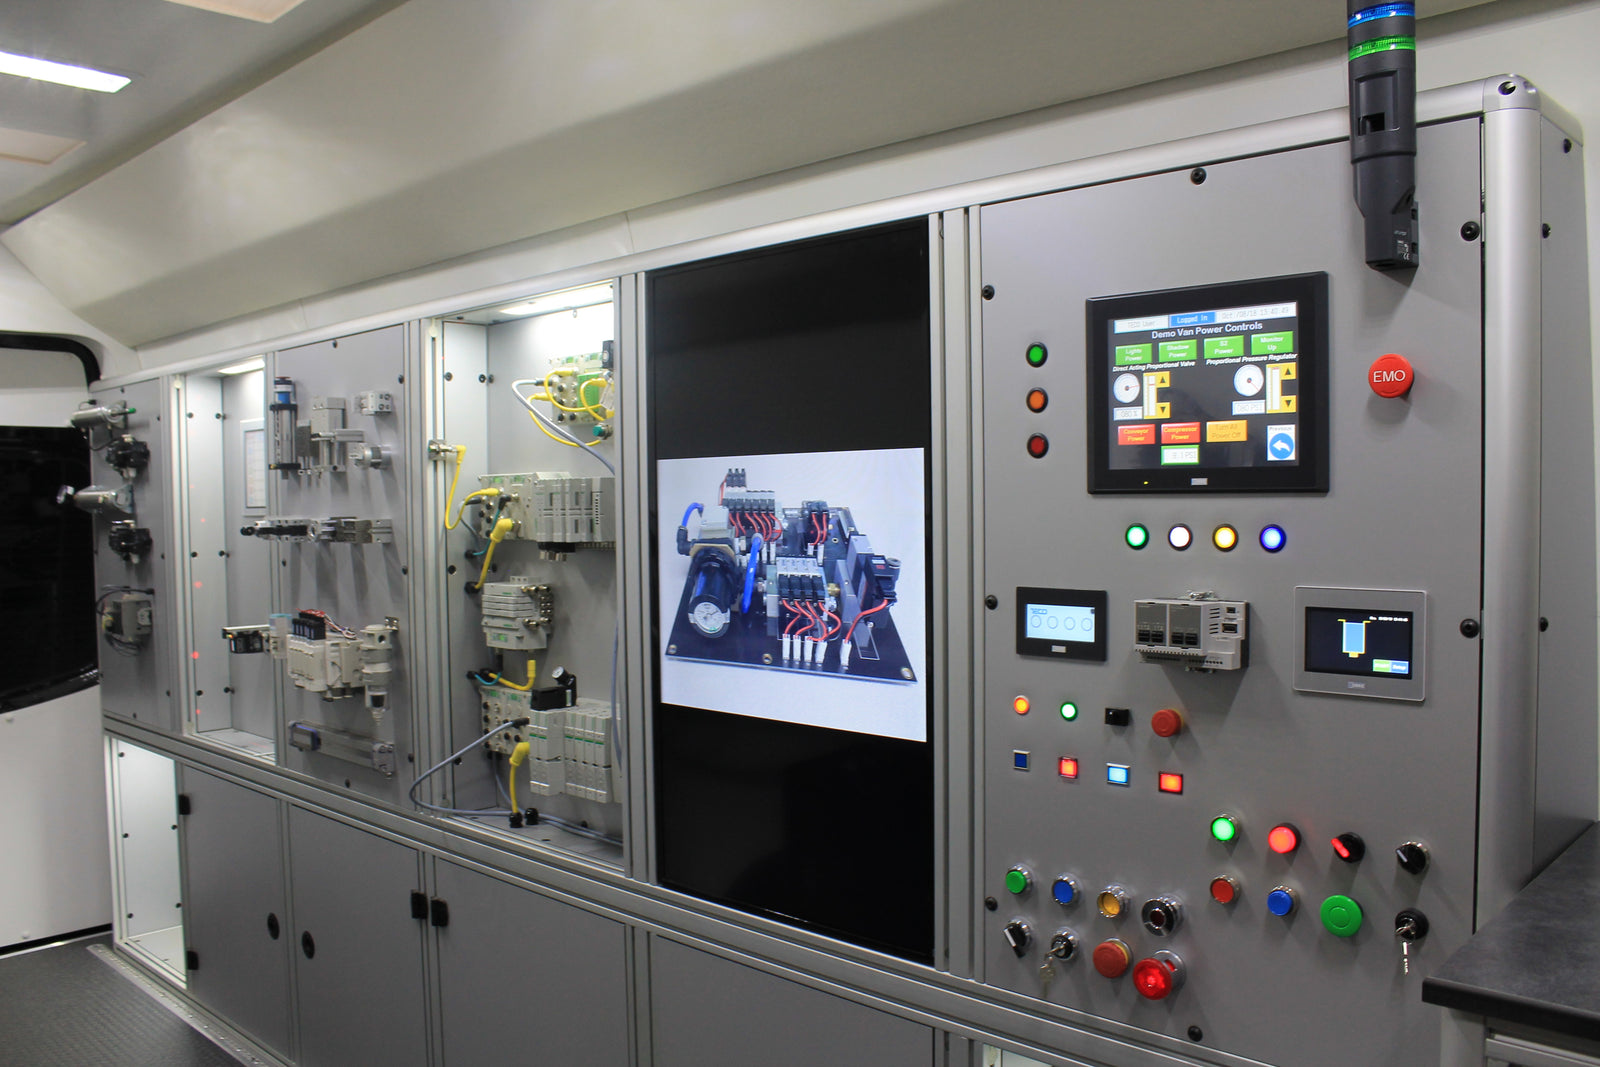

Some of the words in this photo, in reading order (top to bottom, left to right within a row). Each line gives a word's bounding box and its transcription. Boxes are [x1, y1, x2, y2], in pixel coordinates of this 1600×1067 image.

[1177, 316, 1198, 324] Logged
[1152, 330, 1176, 339] Demo
[1177, 328, 1194, 336] Van
[1195, 326, 1224, 334] Power
[1224, 322, 1263, 332] Controls
[1146, 362, 1179, 370] Proportional
[1206, 357, 1242, 366] Proportional
[1268, 353, 1298, 362] Regulator
[1373, 370, 1406, 383] EMO
